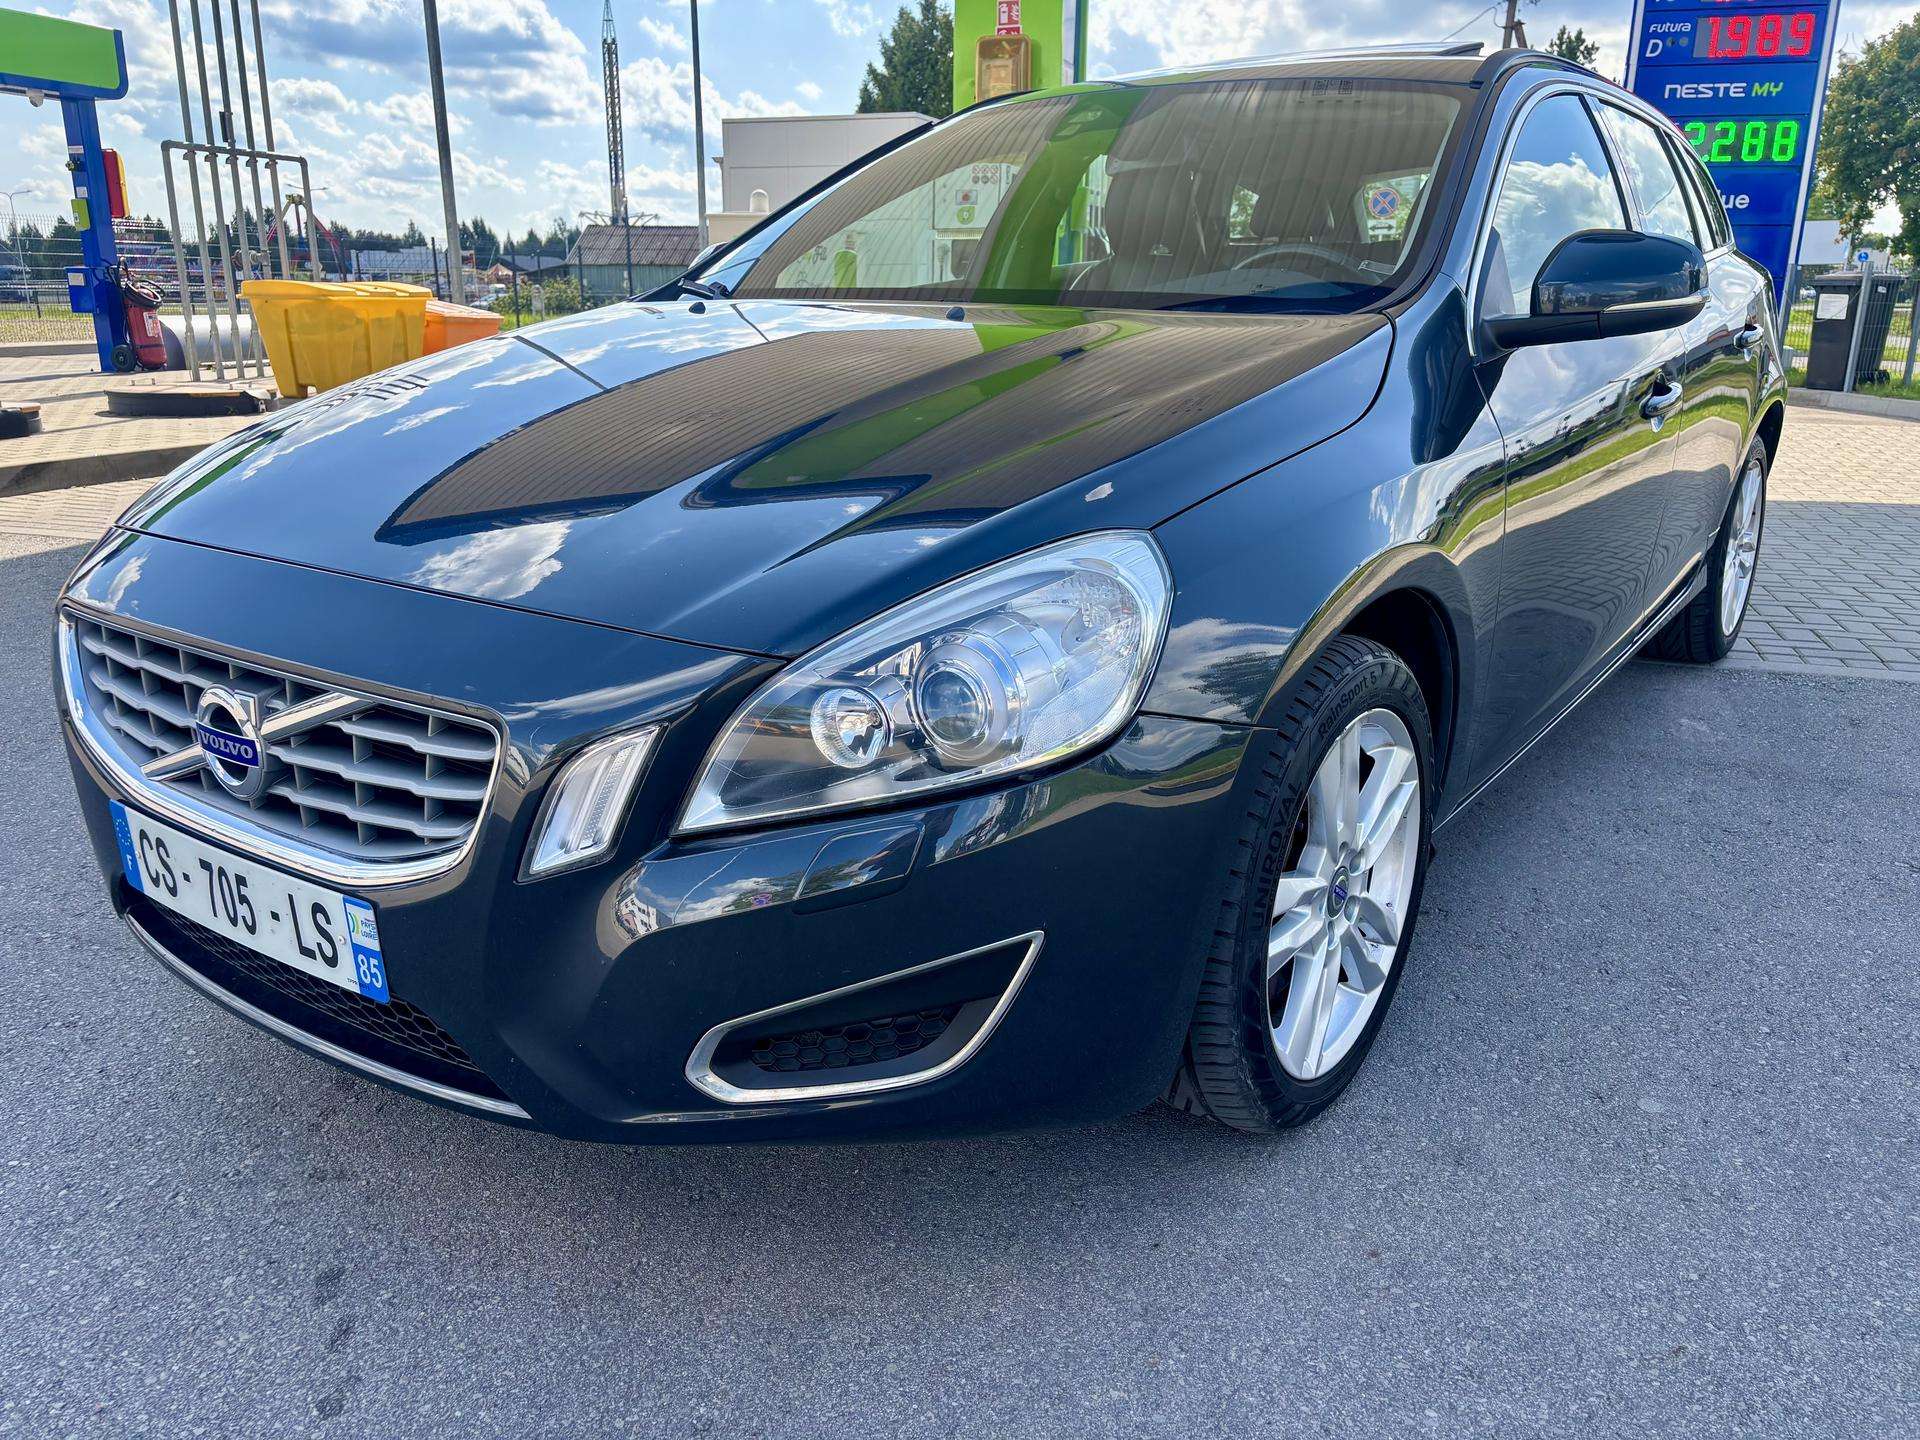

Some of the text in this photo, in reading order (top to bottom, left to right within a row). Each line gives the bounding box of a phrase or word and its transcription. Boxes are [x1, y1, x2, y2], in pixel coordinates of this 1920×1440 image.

[1645, 39, 1663, 58] D
[1664, 82, 1784, 99] NESTE MY
[1318, 670, 1378, 738] RainSport 5
[200, 730, 253, 759] VOLVO
[126, 854, 133, 871] F
[358, 954, 382, 988] 85
